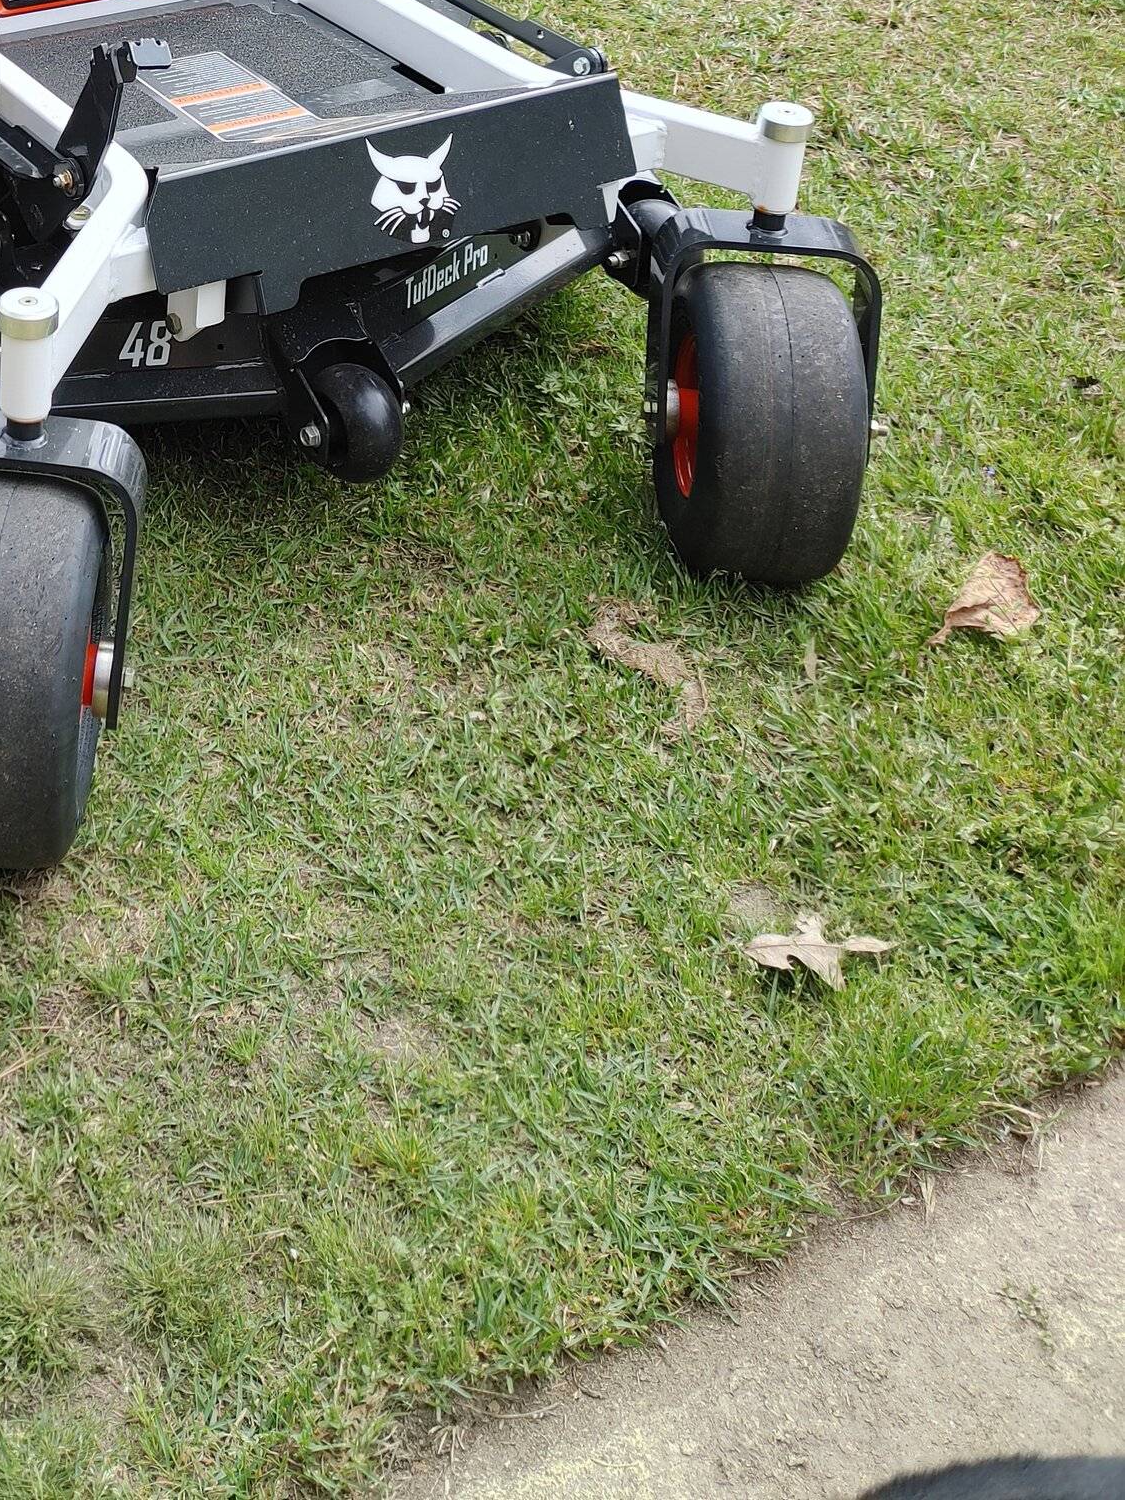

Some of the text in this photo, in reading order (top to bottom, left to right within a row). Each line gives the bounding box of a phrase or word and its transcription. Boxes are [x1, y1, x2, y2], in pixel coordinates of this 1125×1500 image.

[405, 242, 489, 309] TufDeck Pro
[119, 320, 172, 367] 48
